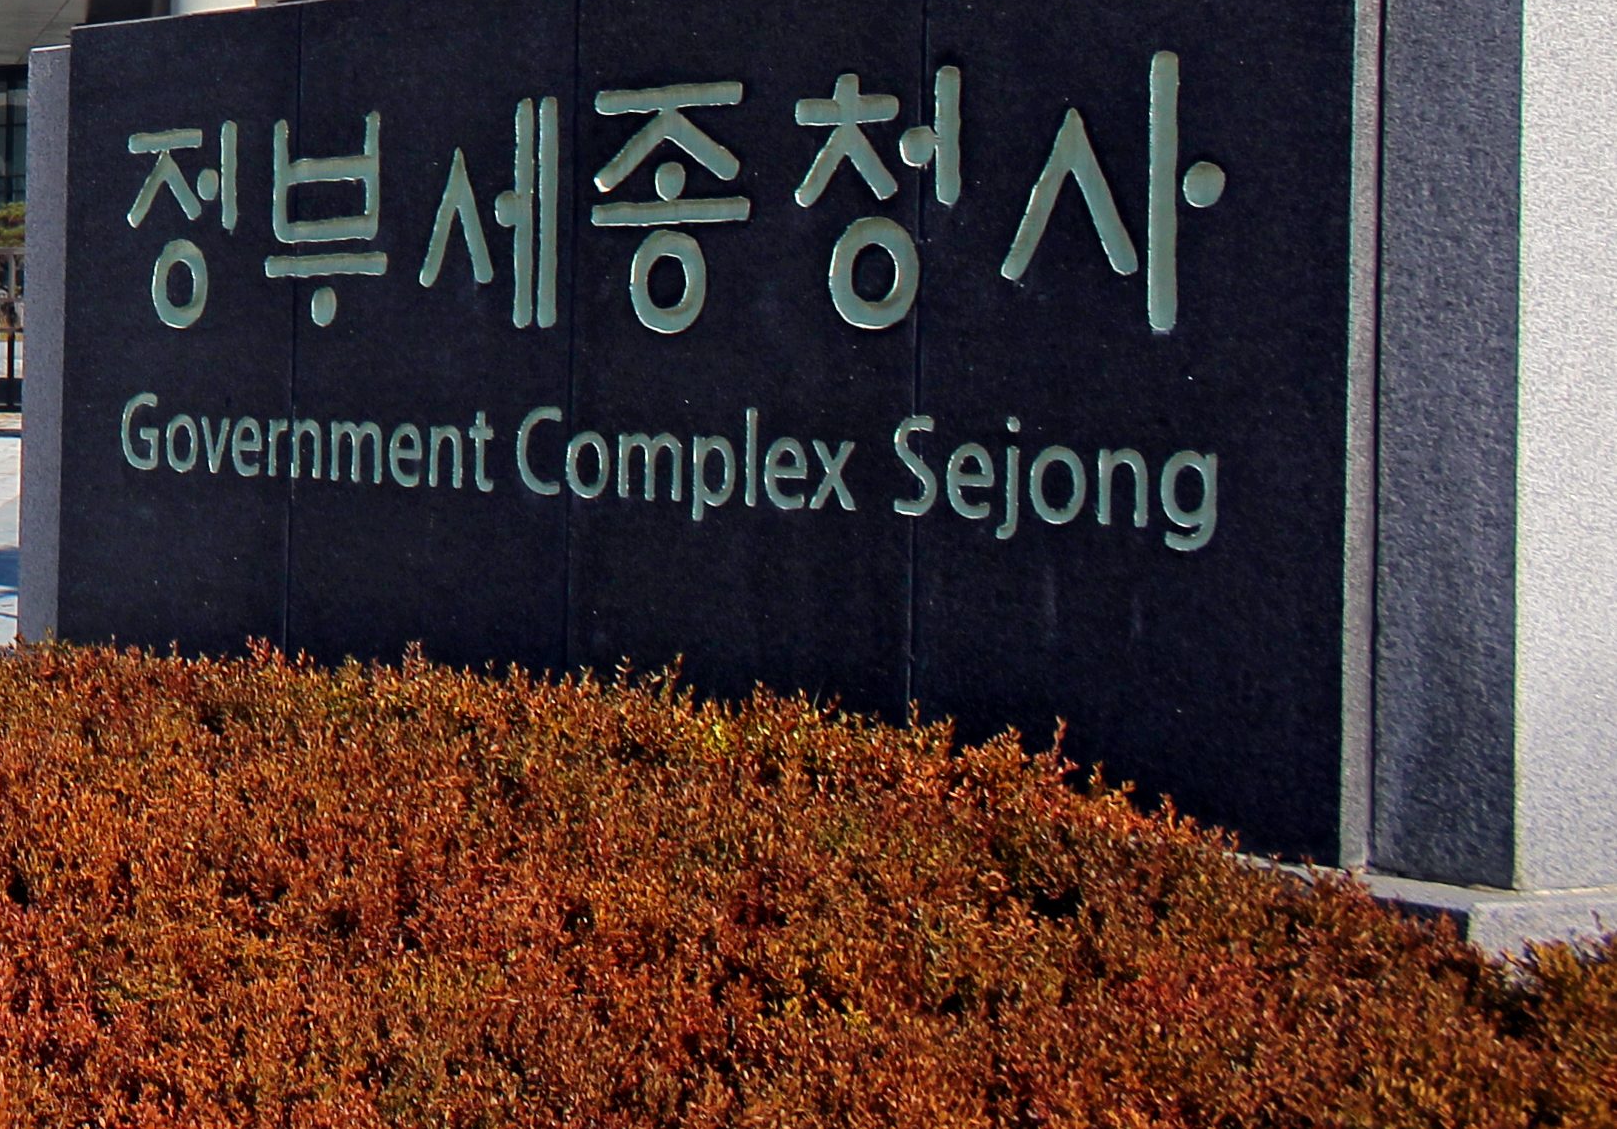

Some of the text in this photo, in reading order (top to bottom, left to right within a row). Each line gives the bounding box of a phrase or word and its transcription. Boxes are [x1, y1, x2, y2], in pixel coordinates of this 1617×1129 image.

[127, 50, 1227, 332] 정부세종청사
[121, 392, 1218, 552] Government Complex Sejong
